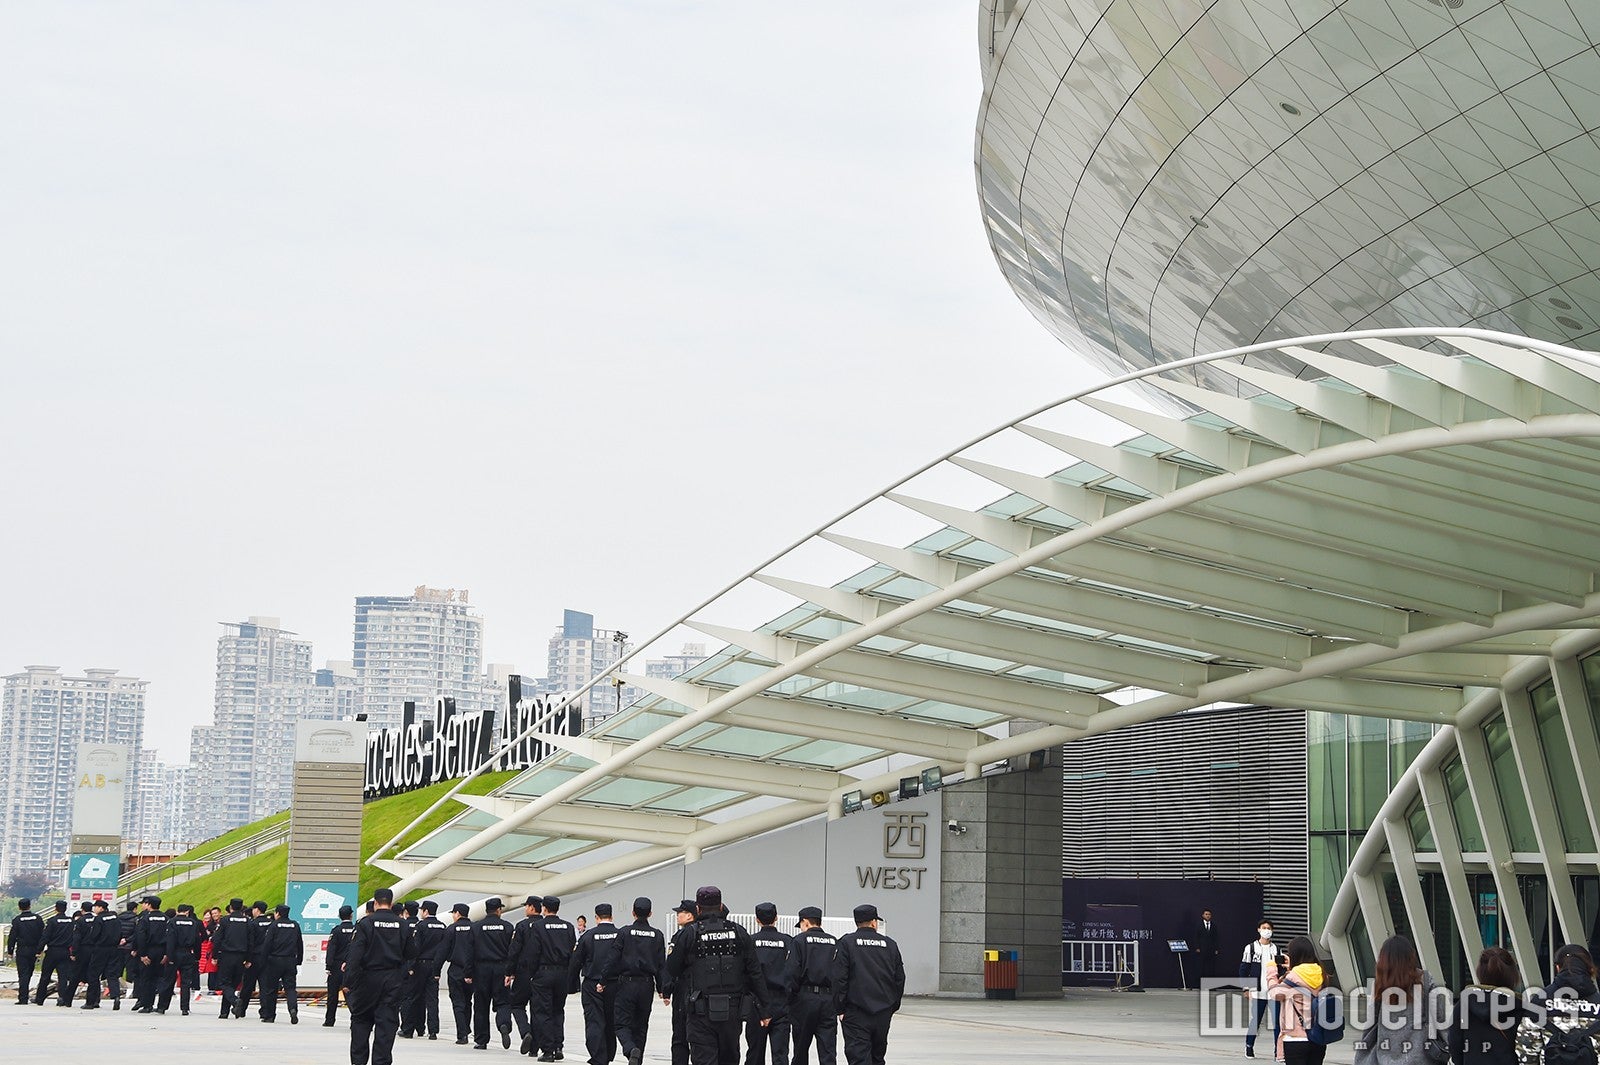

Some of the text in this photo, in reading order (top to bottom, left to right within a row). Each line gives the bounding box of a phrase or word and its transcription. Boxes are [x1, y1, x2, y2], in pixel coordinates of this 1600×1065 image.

[363, 694, 488, 791] rcedes-Benz
[883, 810, 928, 859] 西
[856, 865, 927, 890] WEST
[708, 932, 729, 940] TEQIN
